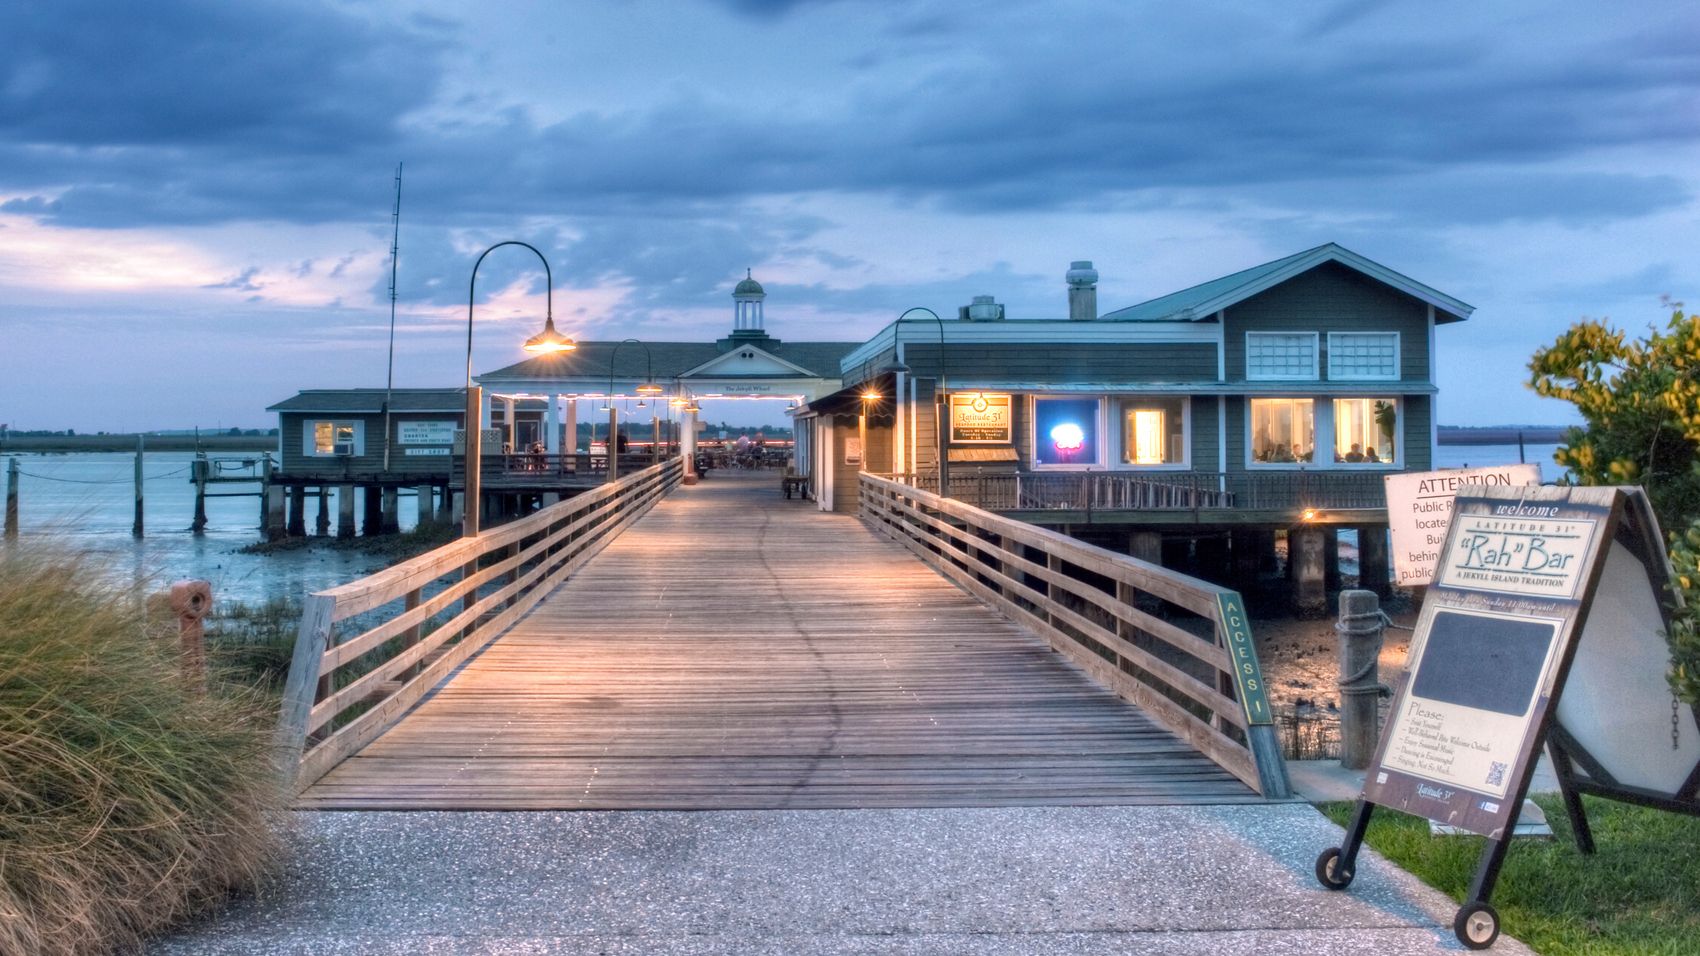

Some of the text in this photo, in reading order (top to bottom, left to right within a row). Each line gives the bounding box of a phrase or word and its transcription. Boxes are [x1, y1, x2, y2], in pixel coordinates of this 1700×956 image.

[959, 413, 991, 423] Latitude
[1418, 473, 1511, 494] ATTENTION
[1412, 501, 1444, 513] Public
[1496, 496, 1559, 517] welcome
[1415, 518, 1447, 530] locate
[1476, 521, 1545, 532] LATITUDE
[1427, 533, 1445, 545] Bui
[1409, 550, 1439, 562] behin
[1521, 536, 1574, 571] Bar
[1401, 567, 1433, 581] public
[1462, 572, 1489, 581] JEKYLL
[1491, 574, 1520, 584] ISLAND
[1521, 577, 1564, 587] TRADITION
[1227, 602, 1258, 691] ACCESS
[1408, 701, 1445, 720] Please:
[1471, 741, 1491, 752] Outside
